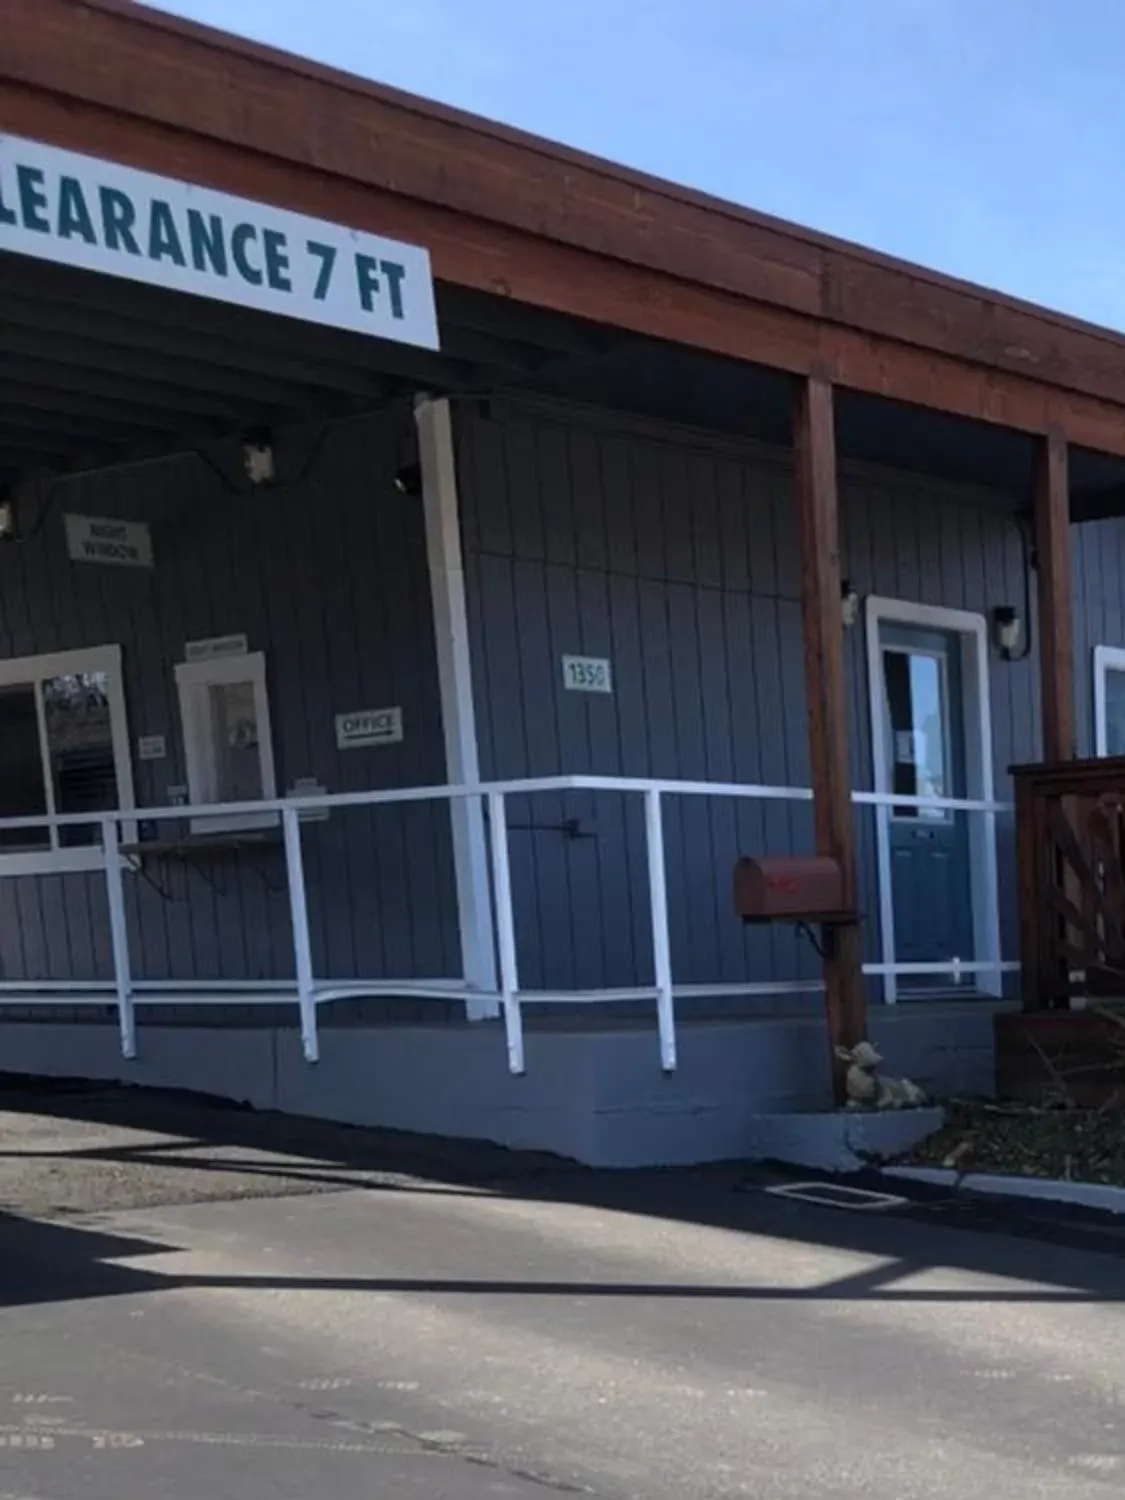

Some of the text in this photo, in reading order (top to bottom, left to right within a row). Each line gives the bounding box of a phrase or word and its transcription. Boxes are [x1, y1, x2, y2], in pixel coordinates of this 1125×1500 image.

[306, 240, 338, 300] 7
[354, 252, 406, 320] FT
[81, 540, 139, 559] WINDOW
[343, 714, 394, 732] OFFICE
